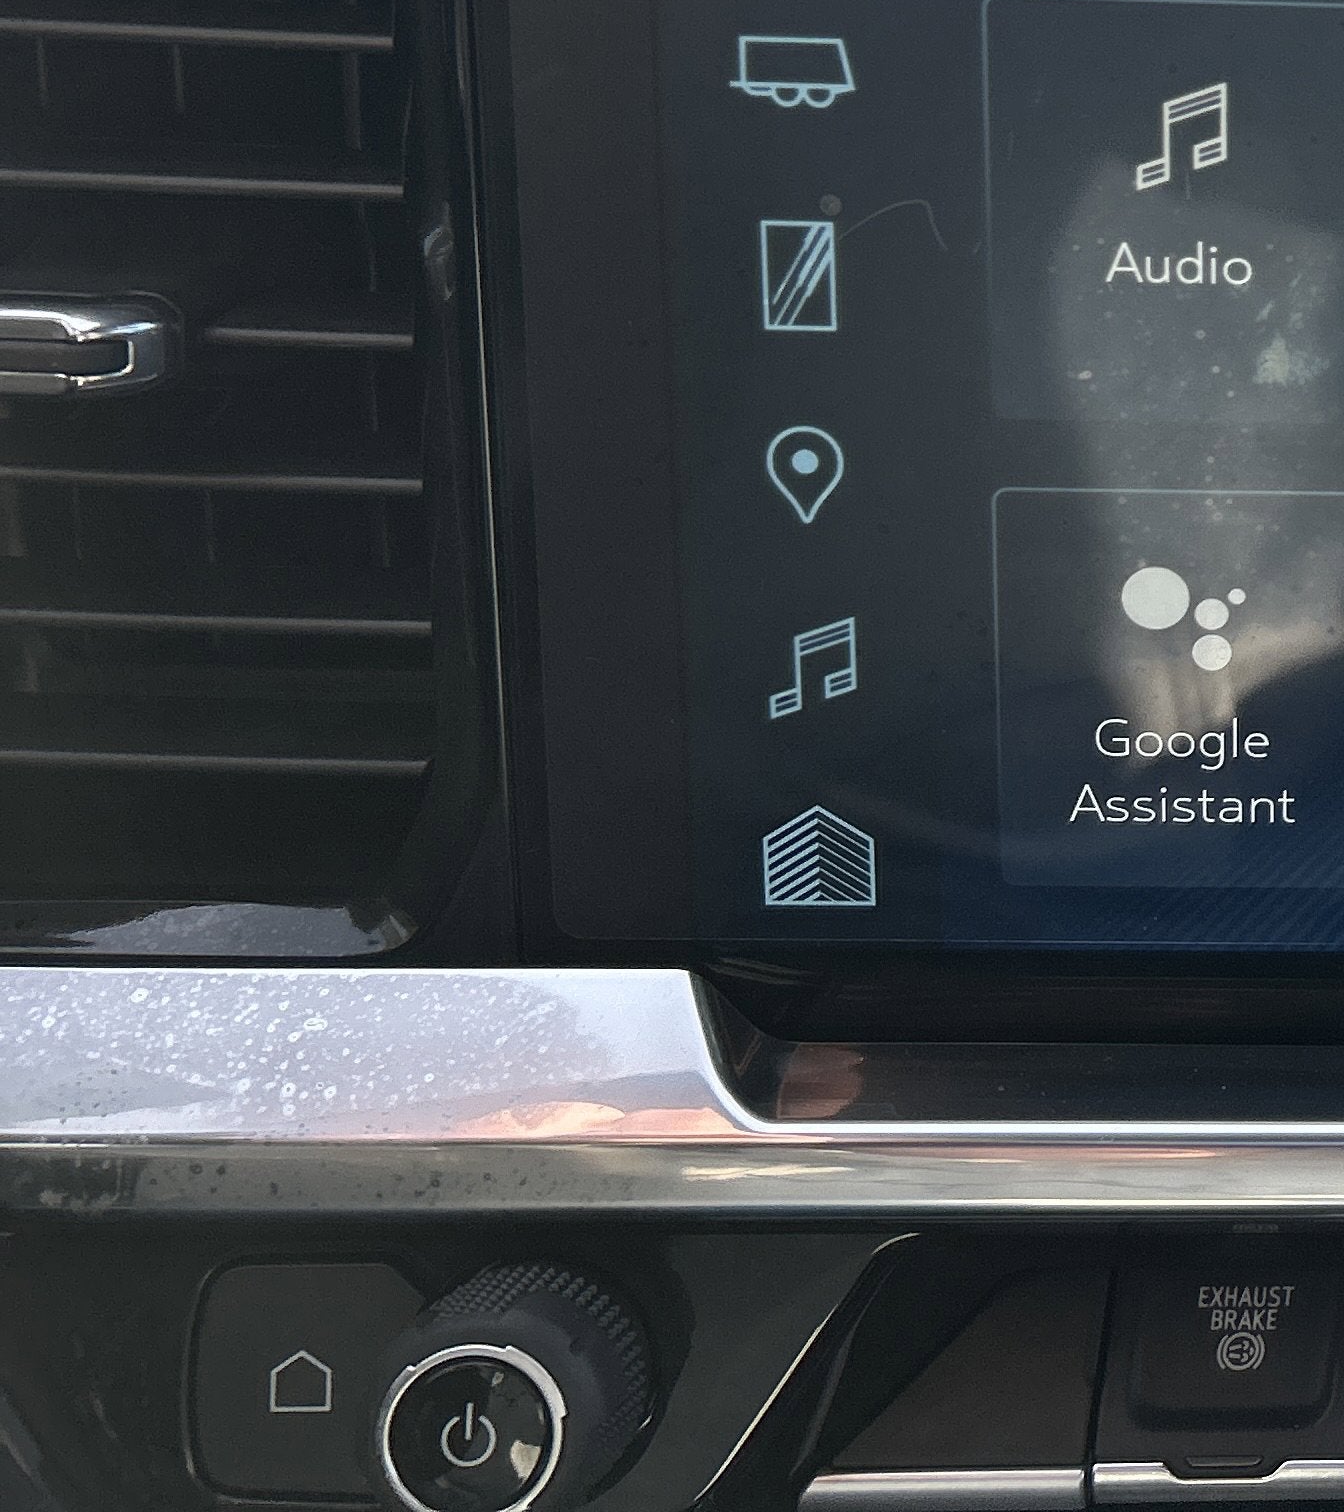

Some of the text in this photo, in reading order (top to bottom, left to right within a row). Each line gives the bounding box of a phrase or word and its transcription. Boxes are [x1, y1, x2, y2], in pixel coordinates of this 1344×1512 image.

[1105, 241, 1254, 286] Audio
[1094, 718, 1271, 770] Google
[1068, 784, 1297, 824] Assistant
[1197, 1285, 1295, 1309] EXHAUST
[1210, 1308, 1279, 1331] BRAKE
